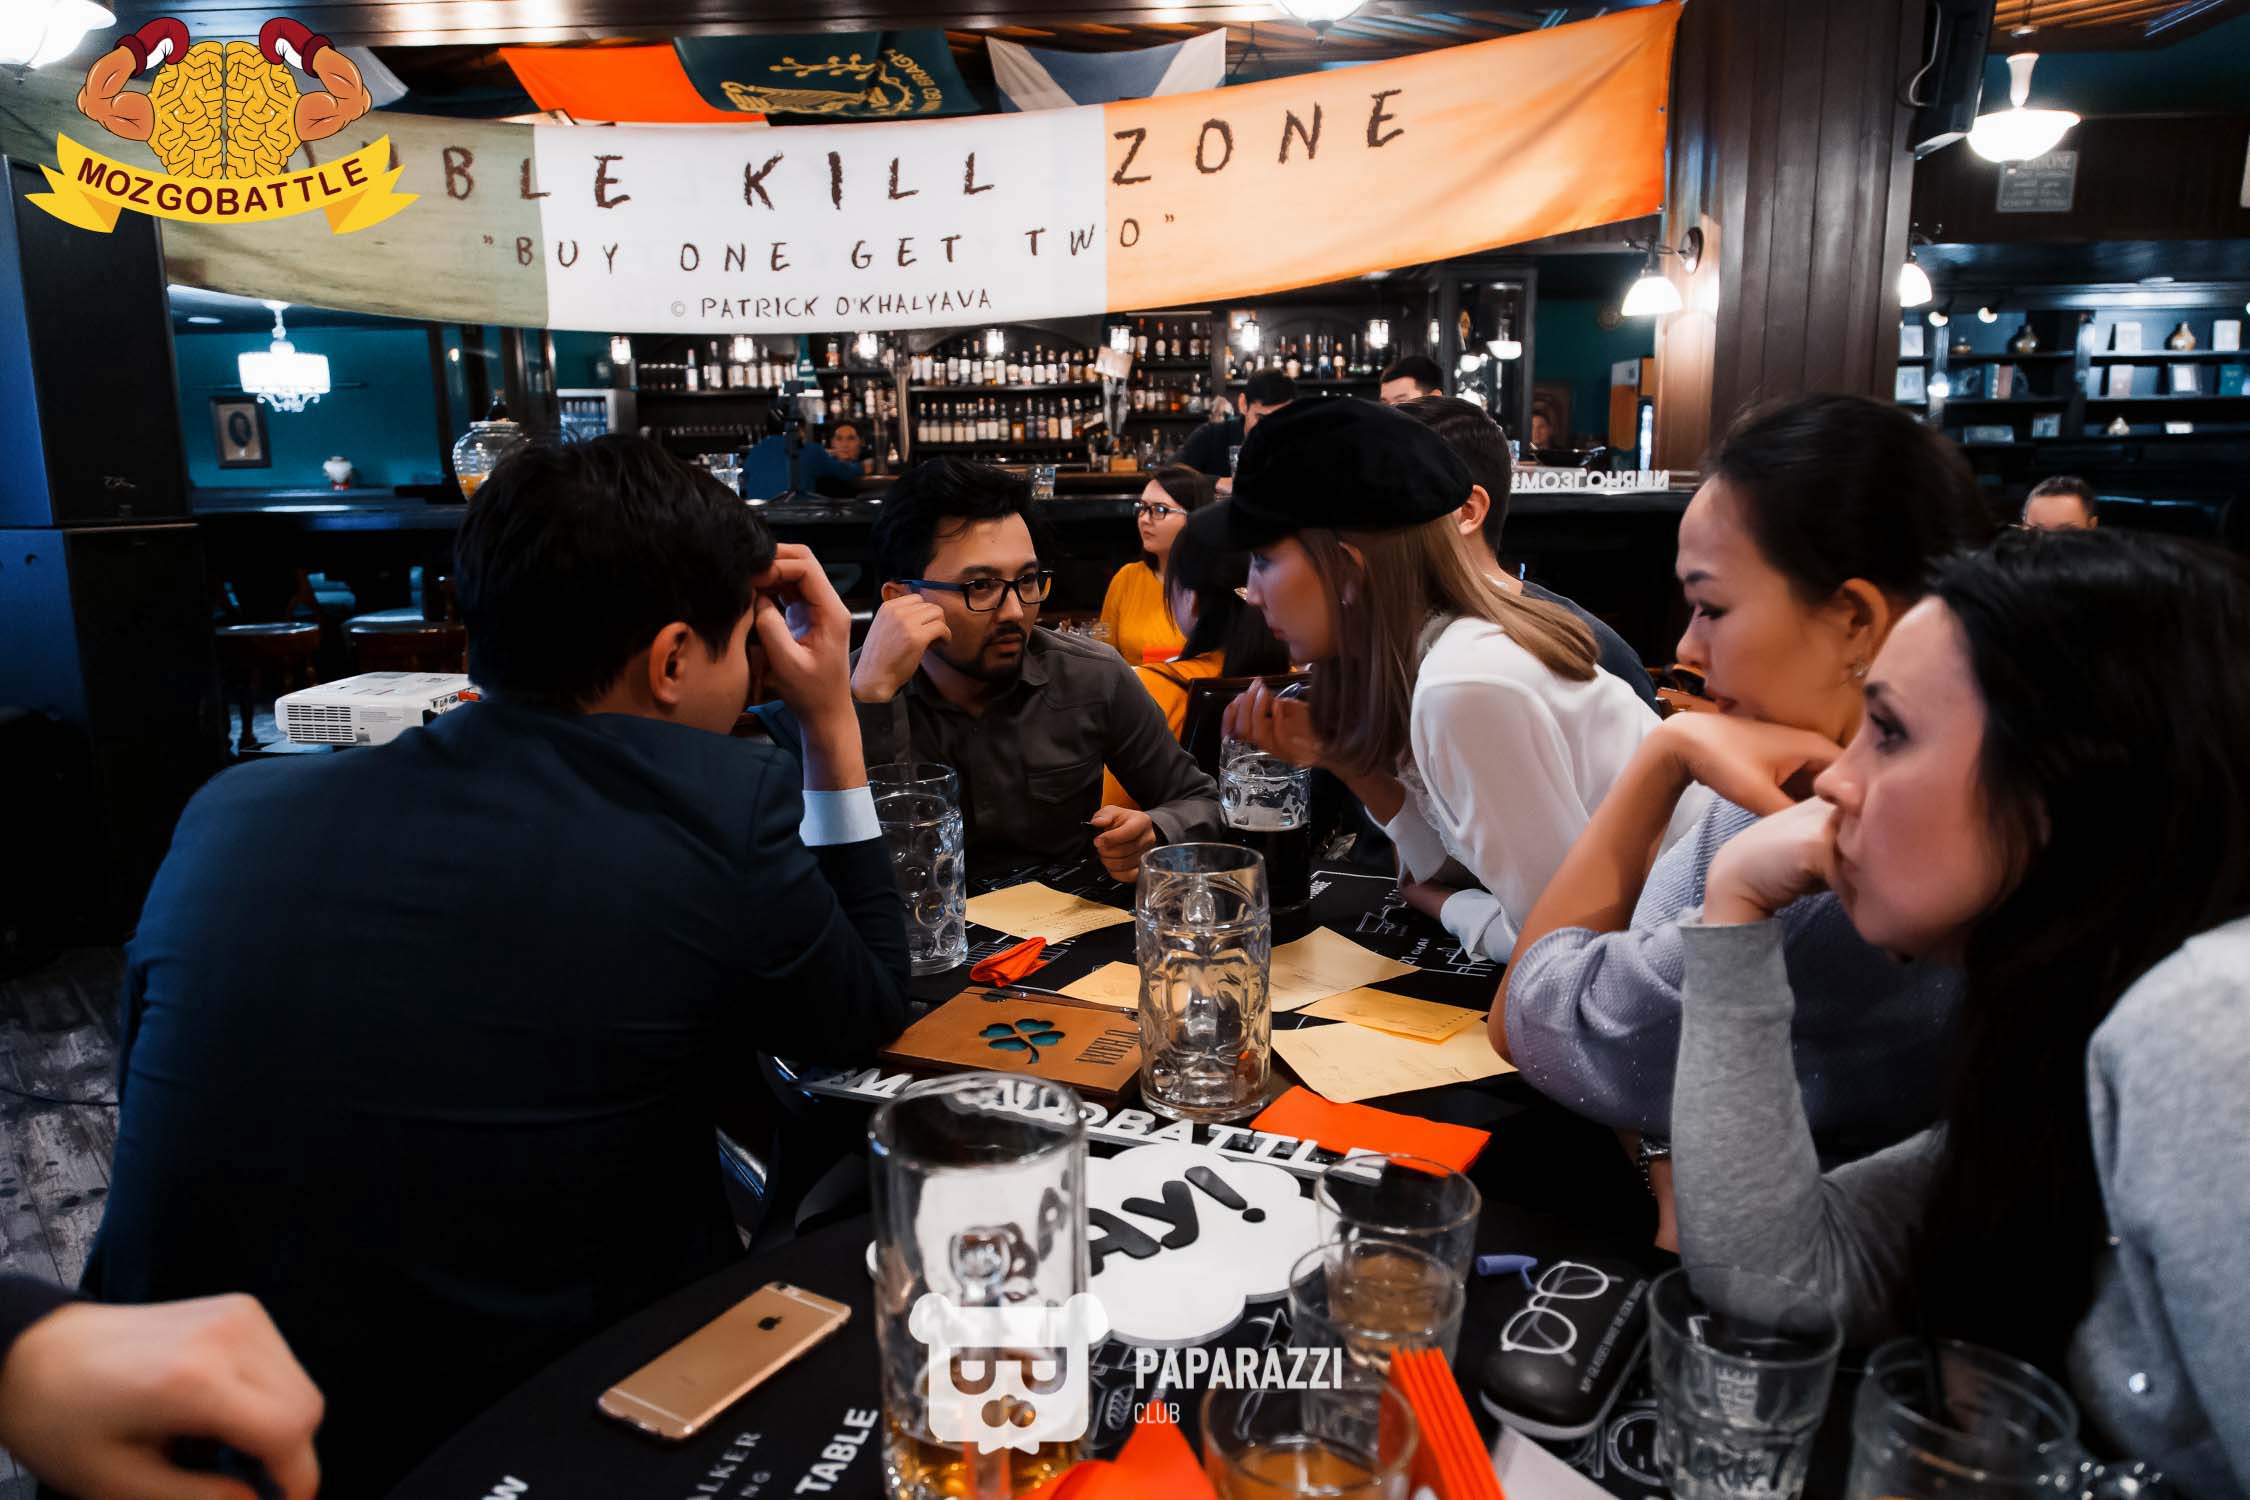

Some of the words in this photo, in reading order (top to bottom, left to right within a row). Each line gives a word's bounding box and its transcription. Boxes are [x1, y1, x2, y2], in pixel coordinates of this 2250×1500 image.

[362, 142, 631, 209] BLE
[743, 150, 995, 210] KILL
[1111, 88, 1405, 186] ZONE
[679, 241, 791, 272] ONE
[850, 234, 963, 269] GET
[700, 295, 819, 318] PATRICK
[835, 287, 993, 316] O'KHALYAVA
[794, 1408, 879, 1494] TABLE
